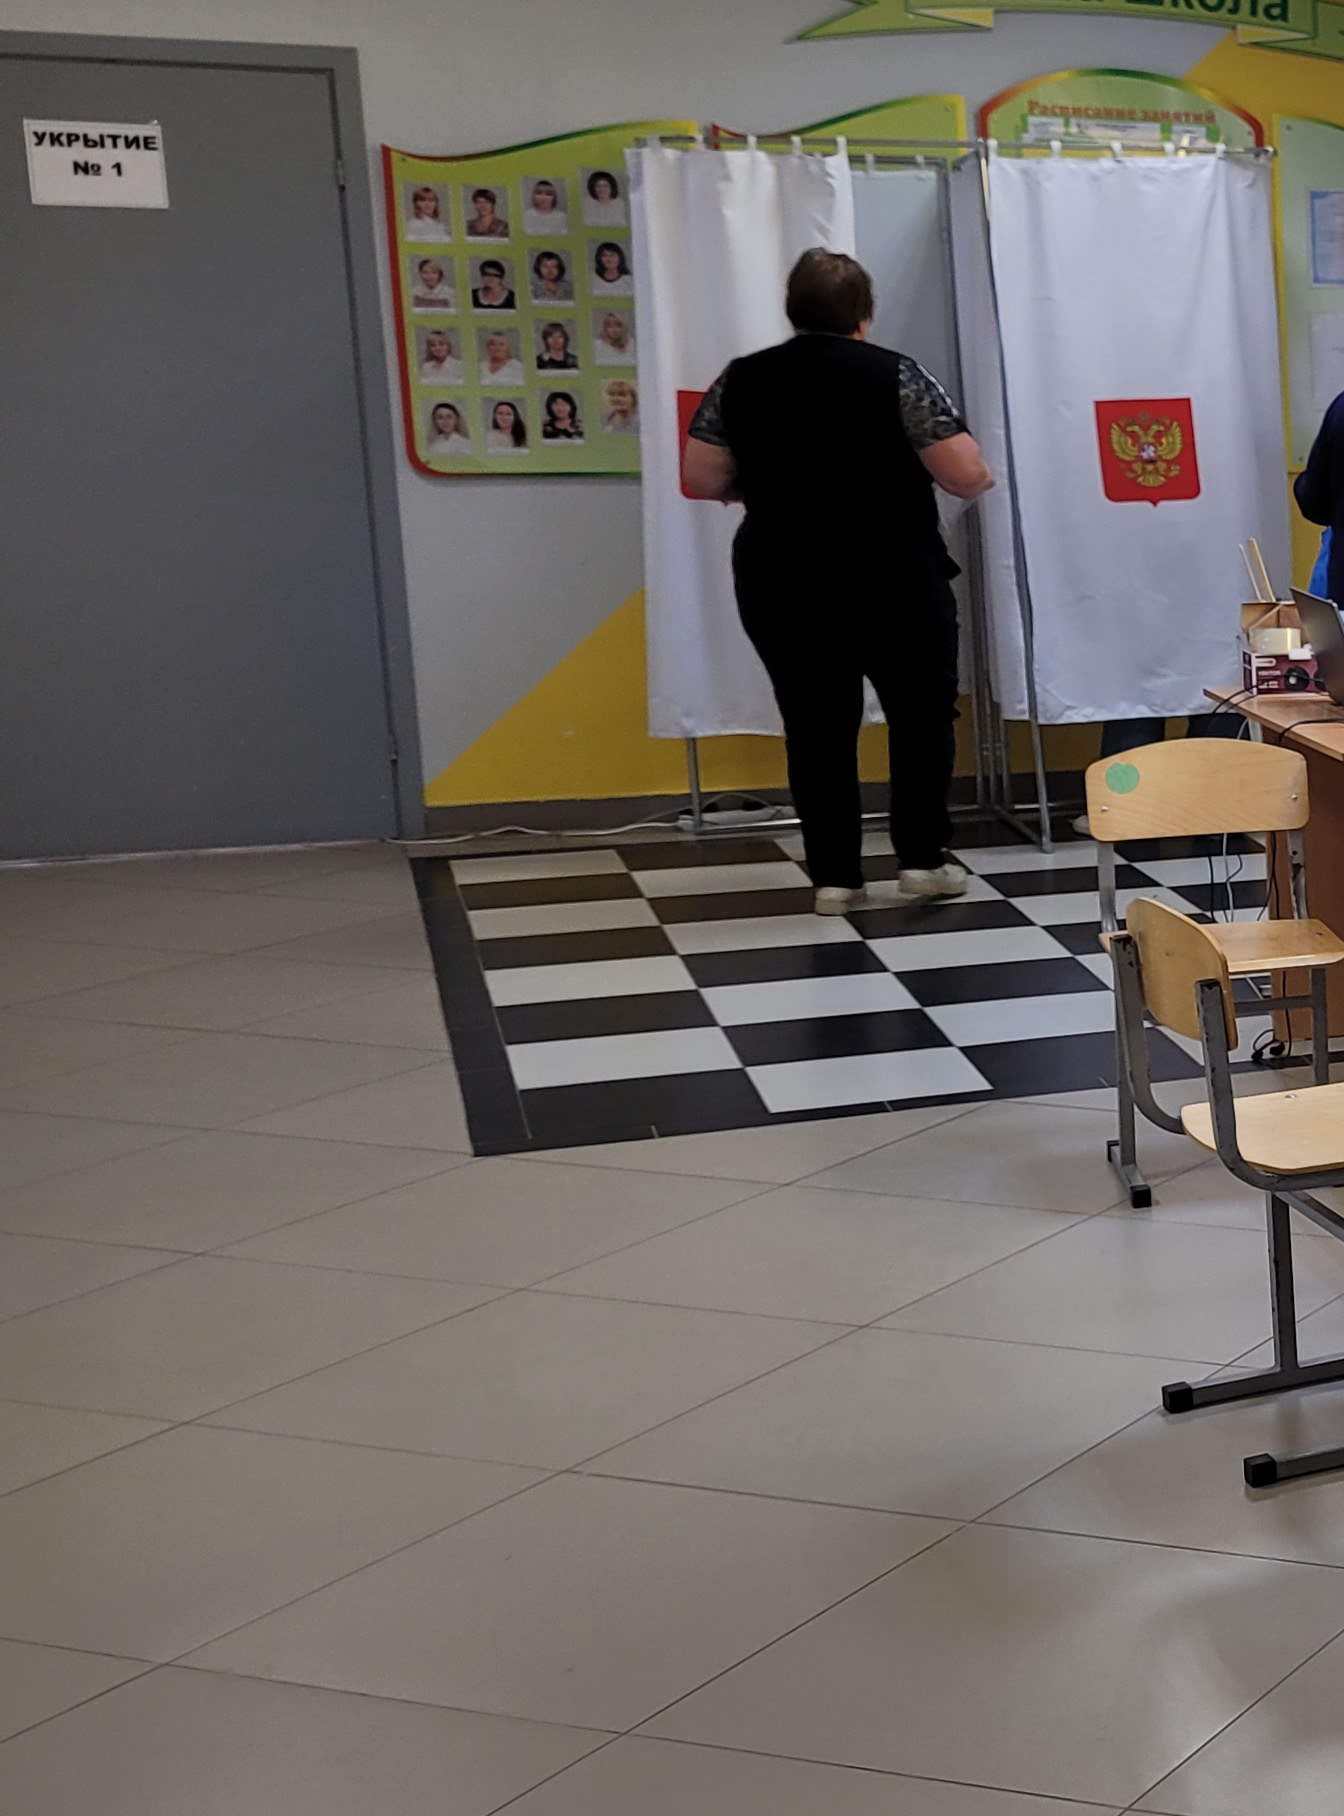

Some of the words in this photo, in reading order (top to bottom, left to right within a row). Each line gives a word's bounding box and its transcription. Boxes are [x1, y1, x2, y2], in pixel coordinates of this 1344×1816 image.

[33, 131, 159, 151] УКРЫТИЕ
[73, 160, 102, 176] №
[111, 161, 123, 177] 1
